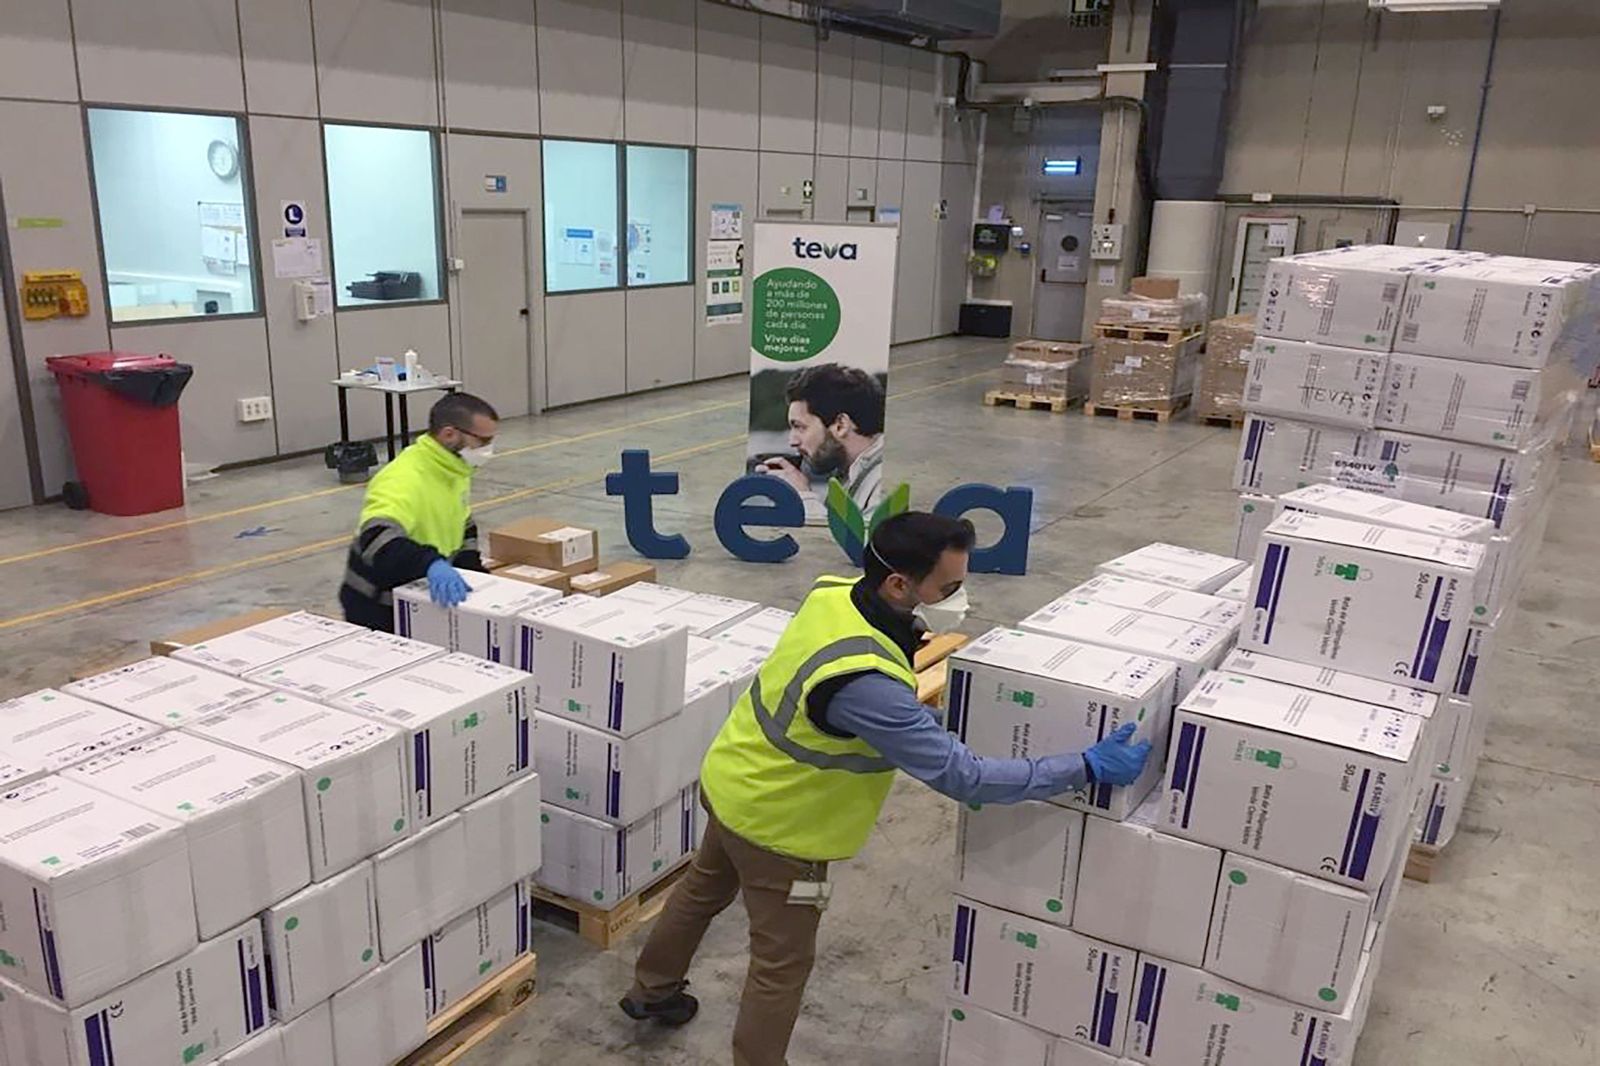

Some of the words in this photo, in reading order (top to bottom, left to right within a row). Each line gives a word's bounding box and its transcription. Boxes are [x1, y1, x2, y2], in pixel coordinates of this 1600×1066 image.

[792, 237, 857, 260] teva
[767, 279, 817, 289] Ayudando
[796, 290, 810, 299] de
[766, 299, 785, 308] 200
[786, 300, 828, 310] millones
[765, 309, 778, 318] de
[780, 311, 826, 321] personas
[765, 320, 789, 329] cada
[764, 333, 788, 343] Vive
[763, 344, 809, 354] mejores.
[1298, 385, 1356, 409] TEVA
[1417, 572, 1430, 585] 50
[1393, 661, 1409, 677] CE
[1088, 701, 1098, 713] 50
[1345, 763, 1357, 776] 50
[1339, 775, 1349, 793] unid
[1320, 856, 1338, 874] CE
[1088, 947, 1098, 959] 50
[1293, 1011, 1304, 1022] 50
[1075, 1024, 1089, 1040] CE
